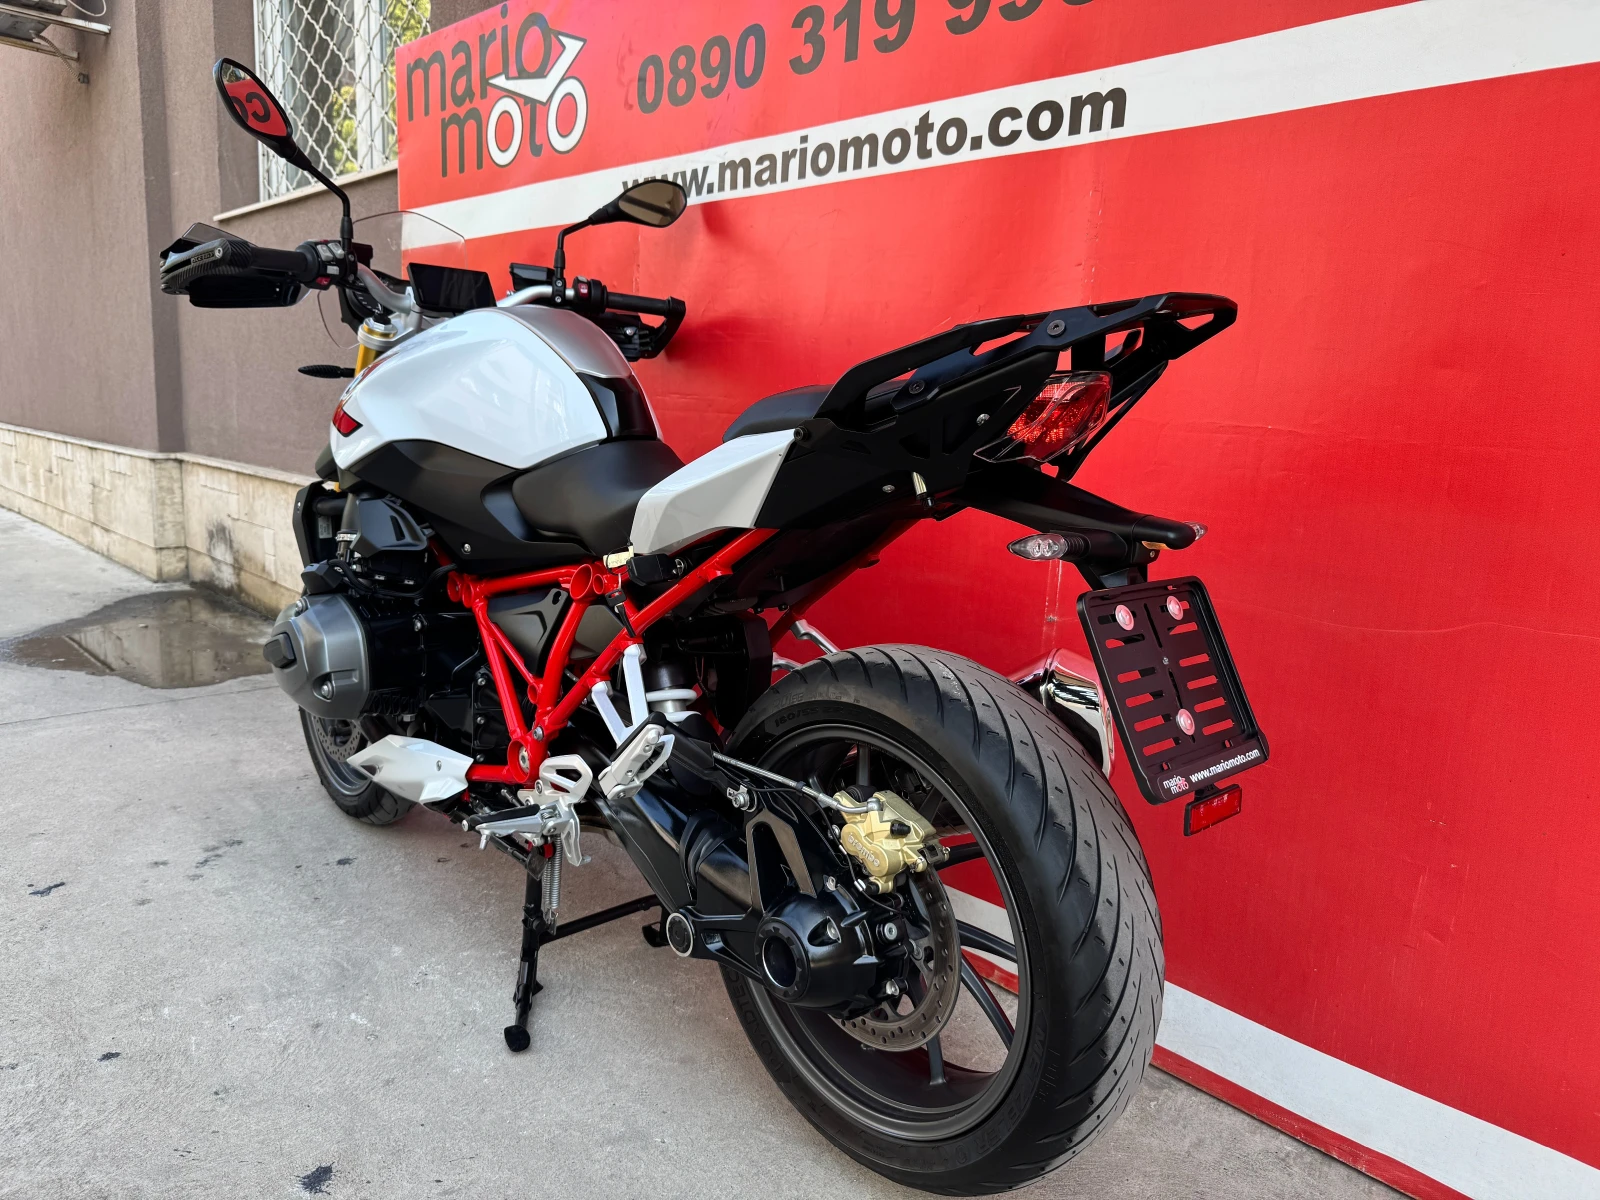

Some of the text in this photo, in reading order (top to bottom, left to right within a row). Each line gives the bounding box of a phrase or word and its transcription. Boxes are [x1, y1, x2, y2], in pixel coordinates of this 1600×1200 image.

[406, 4, 552, 122] mario
[636, 23, 766, 115] 0890
[788, 0, 915, 76] 319
[440, 76, 588, 178] moto
[621, 86, 1128, 200] w.mariomoto.com
[1163, 776, 1182, 788] mario
[1190, 749, 1260, 783] www.mariomoto.com
